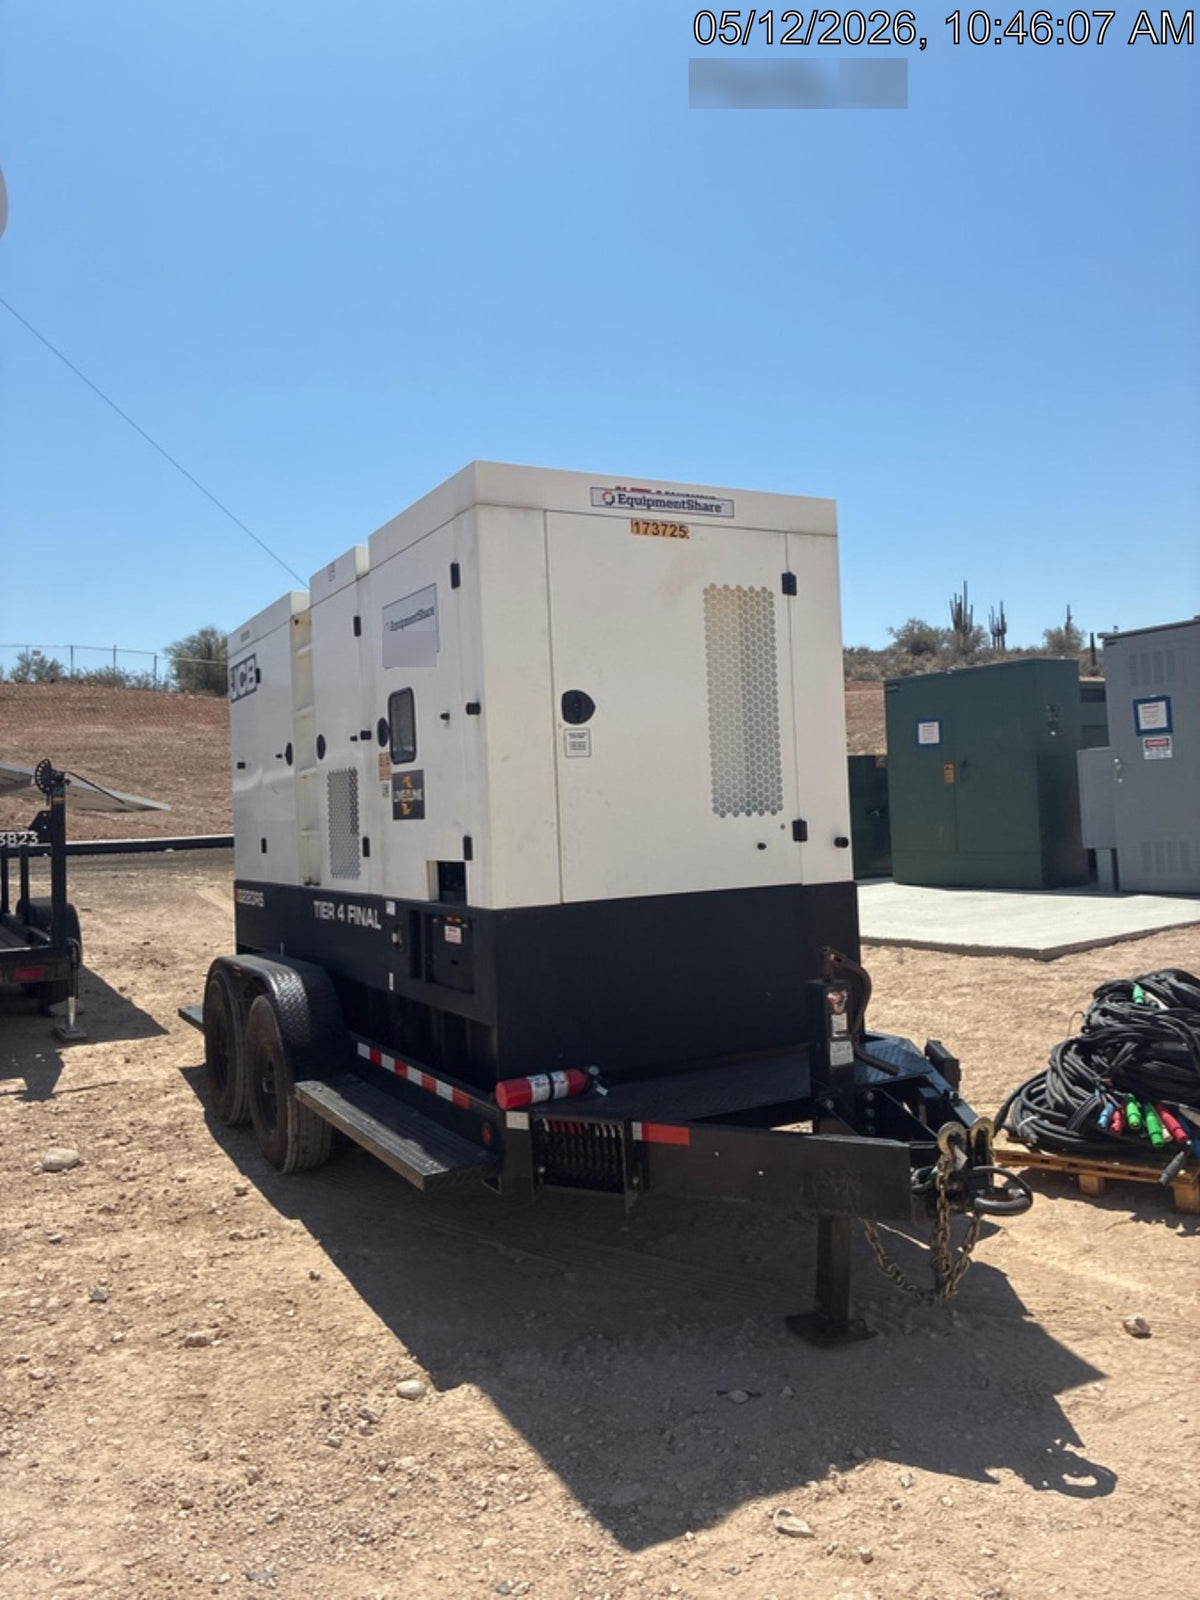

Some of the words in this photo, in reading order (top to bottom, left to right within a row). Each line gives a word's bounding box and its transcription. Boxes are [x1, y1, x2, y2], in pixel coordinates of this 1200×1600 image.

[618, 493, 722, 512] EquipmentShare
[633, 520, 689, 538] 173725
[313, 900, 335, 920] TIER
[336, 903, 346, 923] 4
[347, 904, 382, 930] FINAL
